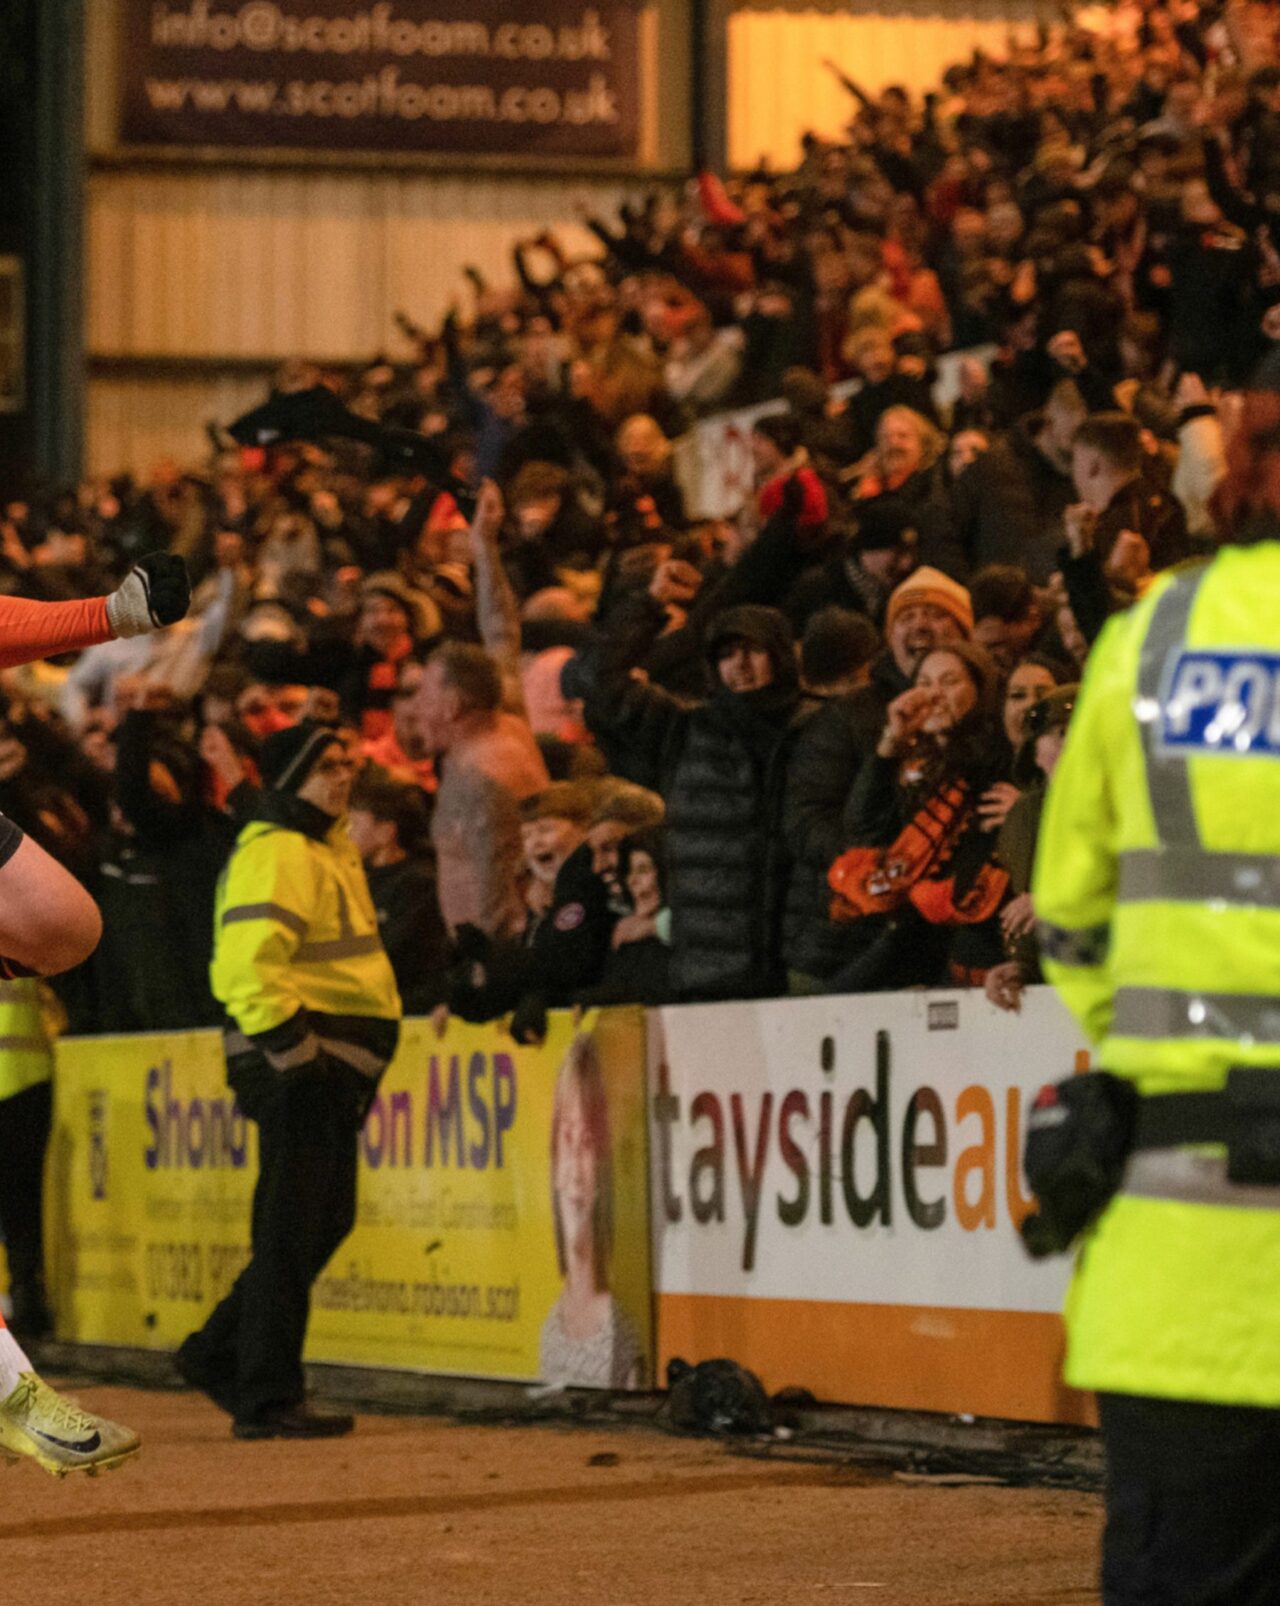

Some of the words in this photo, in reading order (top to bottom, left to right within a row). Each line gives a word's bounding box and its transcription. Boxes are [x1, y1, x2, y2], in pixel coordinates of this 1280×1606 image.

[150, 1, 611, 60] info@scotfoam.co.uk
[145, 64, 619, 126] www.scotfoam.co.uk
[424, 1051, 517, 1170] MSP
